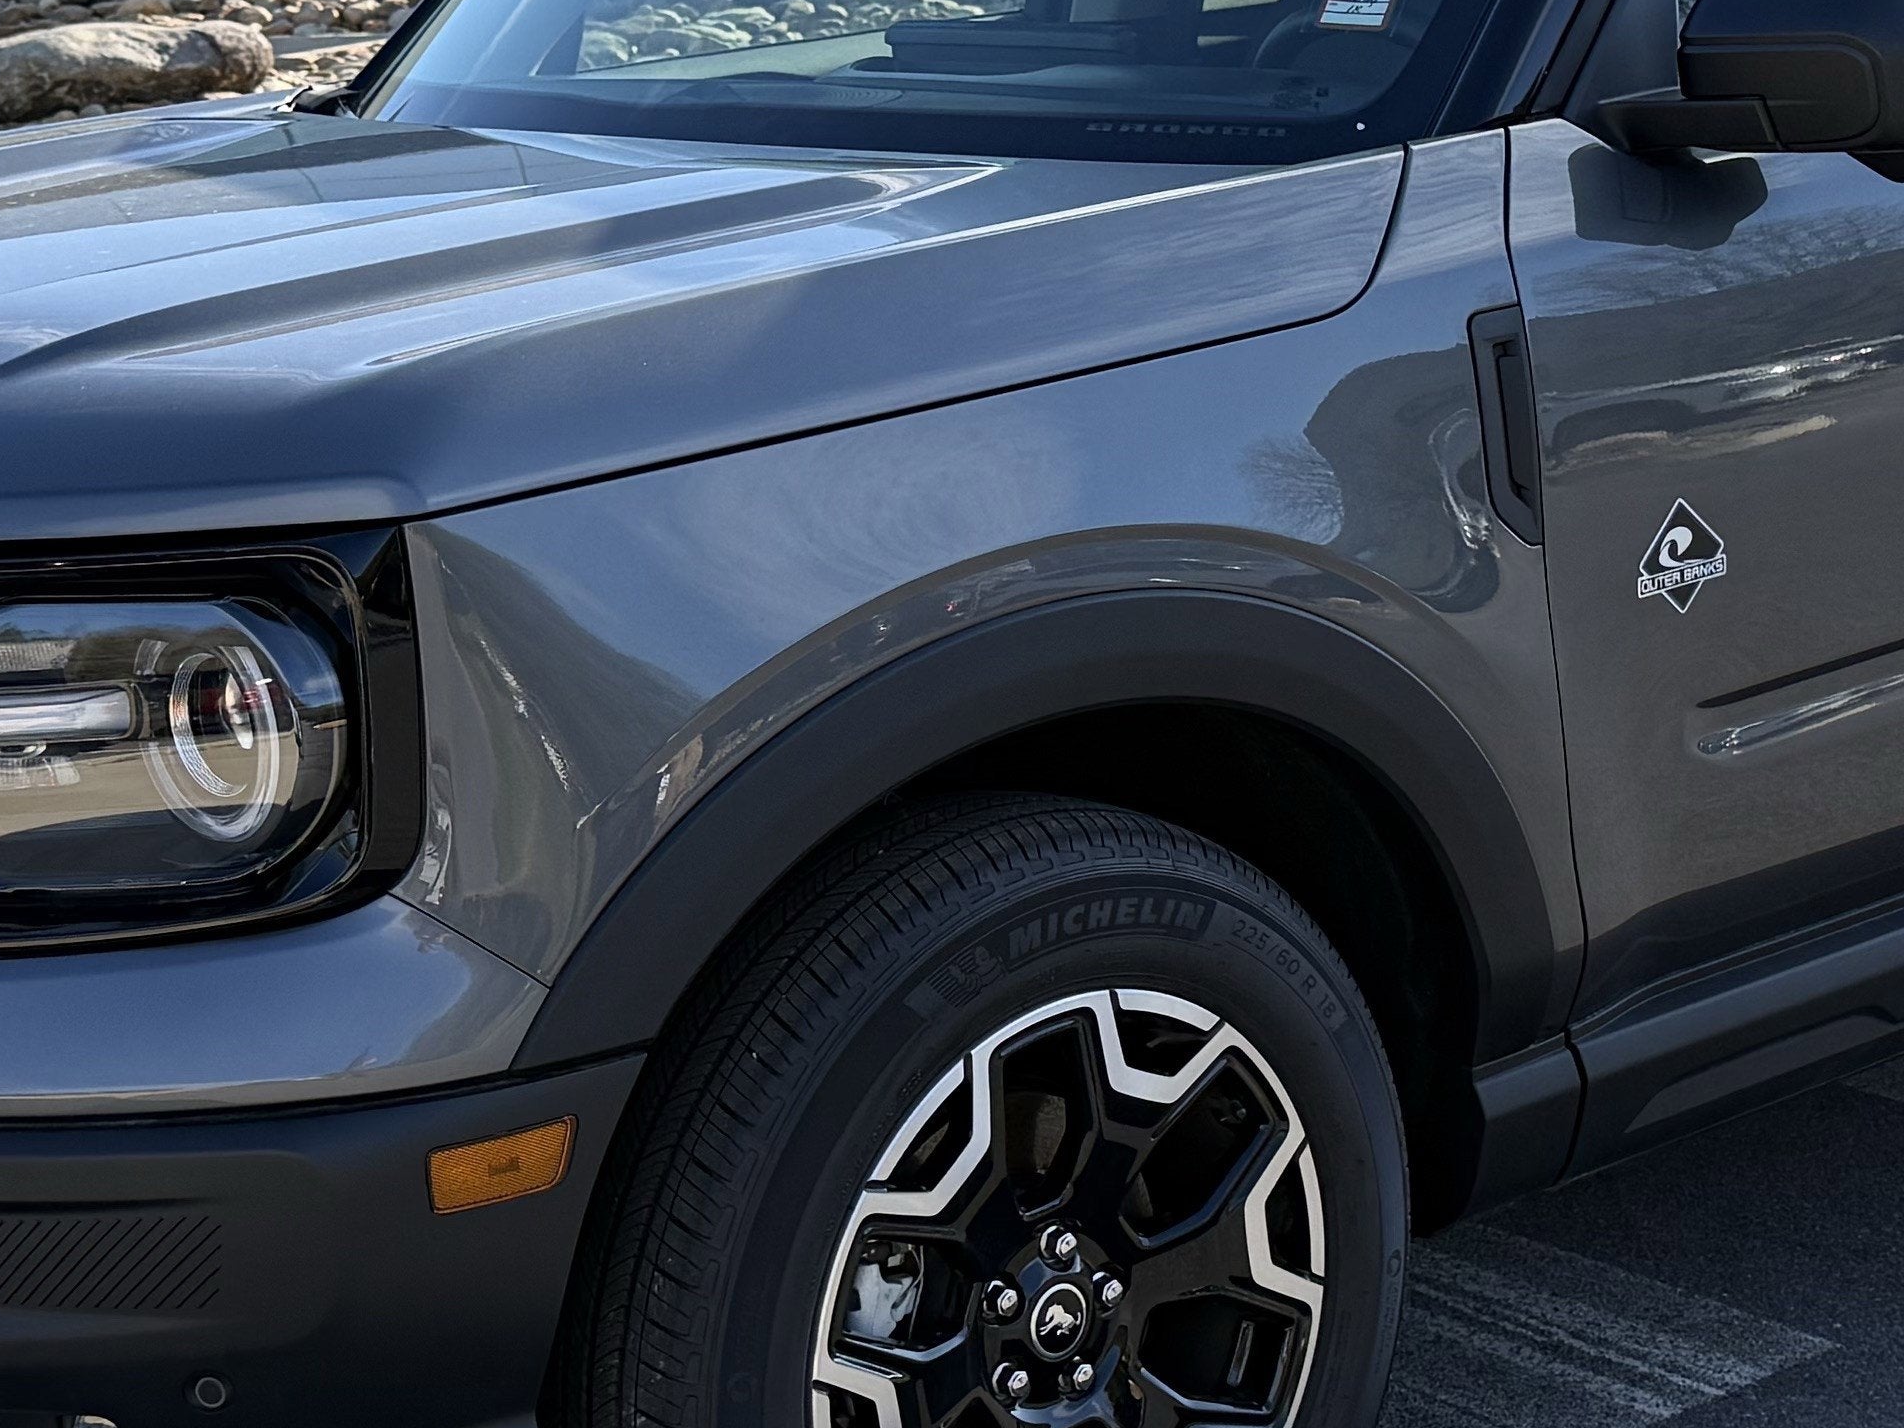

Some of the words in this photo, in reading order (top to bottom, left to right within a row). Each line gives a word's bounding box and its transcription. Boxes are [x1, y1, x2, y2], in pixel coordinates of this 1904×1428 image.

[1641, 571, 1681, 593] OUTER
[1683, 560, 1724, 582] BANKS
[1007, 896, 1206, 960] MICHELIN
[1231, 918, 1302, 976] 225/60
[1301, 975, 1321, 997] R
[1316, 992, 1338, 1020] 18
